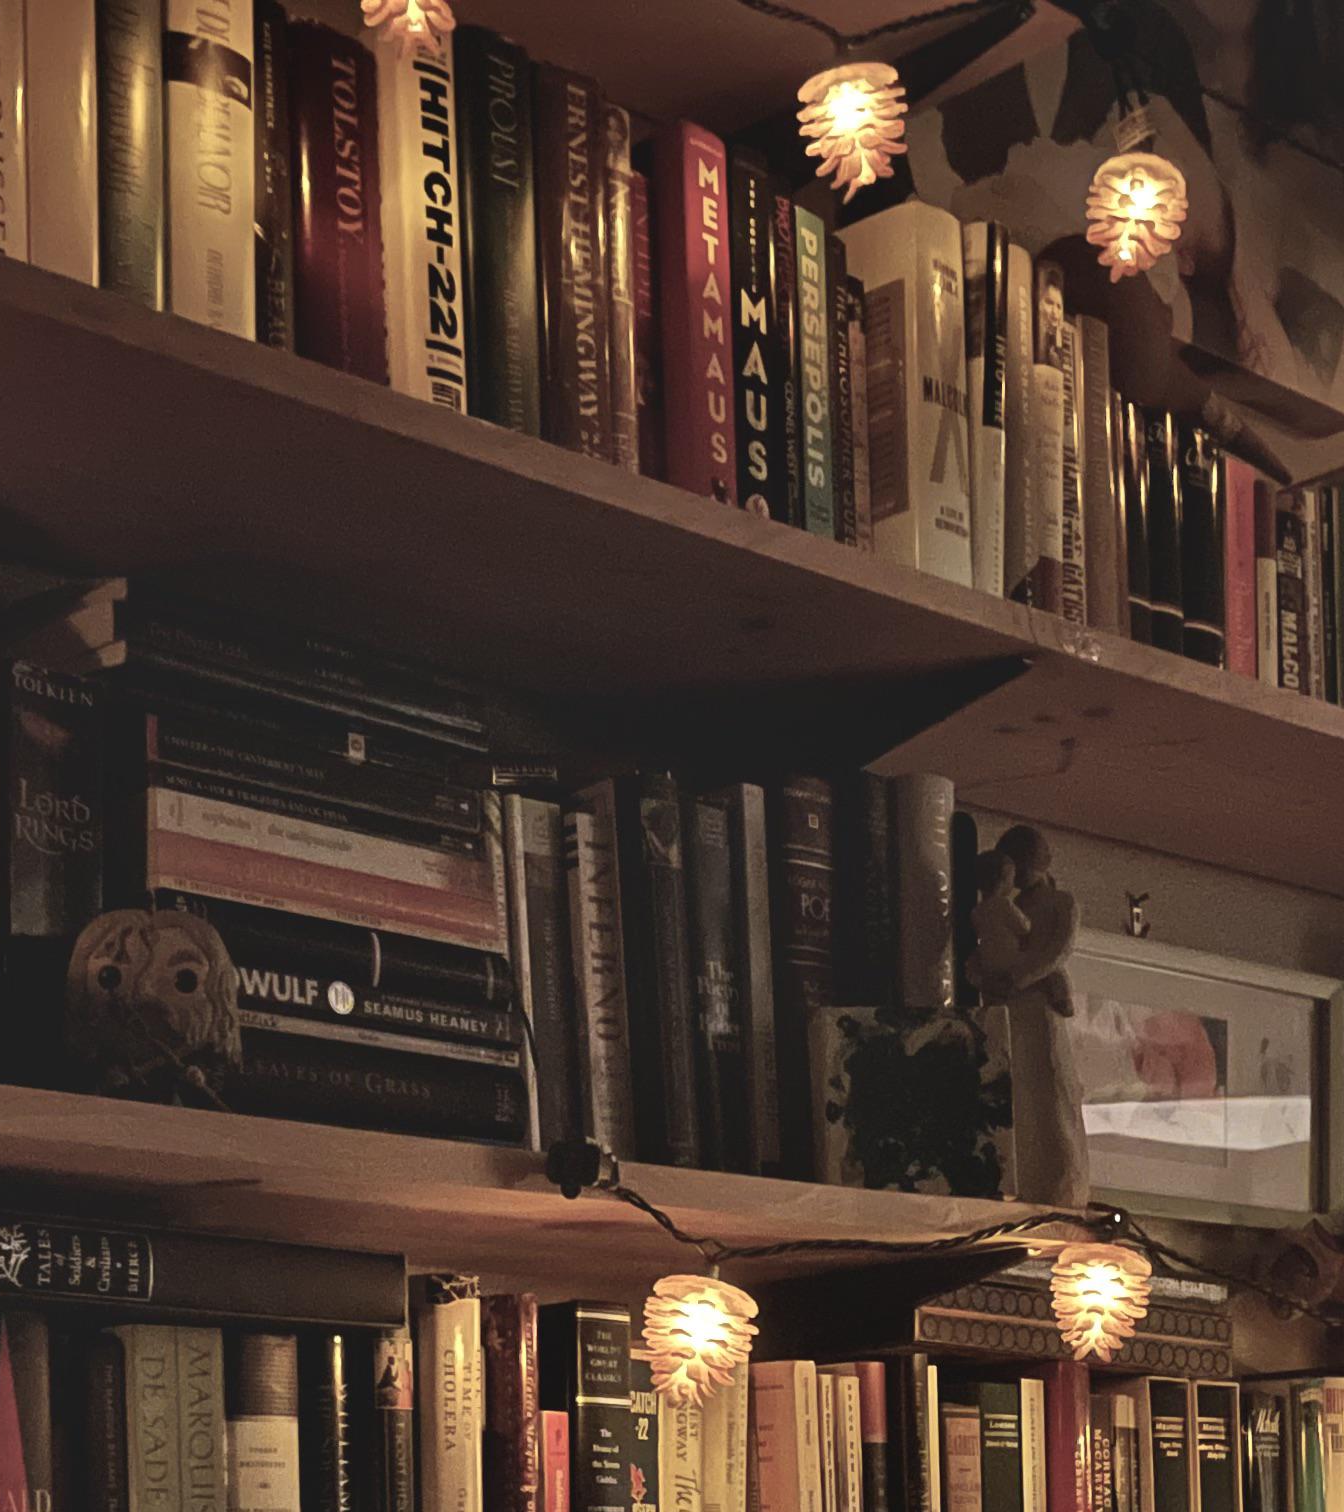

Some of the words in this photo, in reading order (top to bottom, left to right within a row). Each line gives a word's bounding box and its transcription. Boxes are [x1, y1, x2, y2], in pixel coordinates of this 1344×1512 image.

[331, 55, 365, 244] TOLSTOY
[488, 54, 520, 191] PROUST
[565, 82, 594, 212] ERNEST
[419, 76, 458, 342] HITCH-22
[571, 214, 601, 422] HEMINGWAY
[698, 158, 729, 468] METAMAUS
[799, 225, 825, 489] PERSEPOLIS
[740, 288, 769, 482] MAUS
[12, 673, 97, 707] TOLKIEN
[362, 999, 424, 1024] SEAMUS
[429, 1008, 489, 1034] HEANEY
[141, 1356, 167, 1389] DE
[443, 1348, 457, 1451] CHOLERA
[142, 1411, 168, 1507] SADE
[675, 1468, 700, 1509] The
[1102, 1437, 1112, 1508] CORMAC
